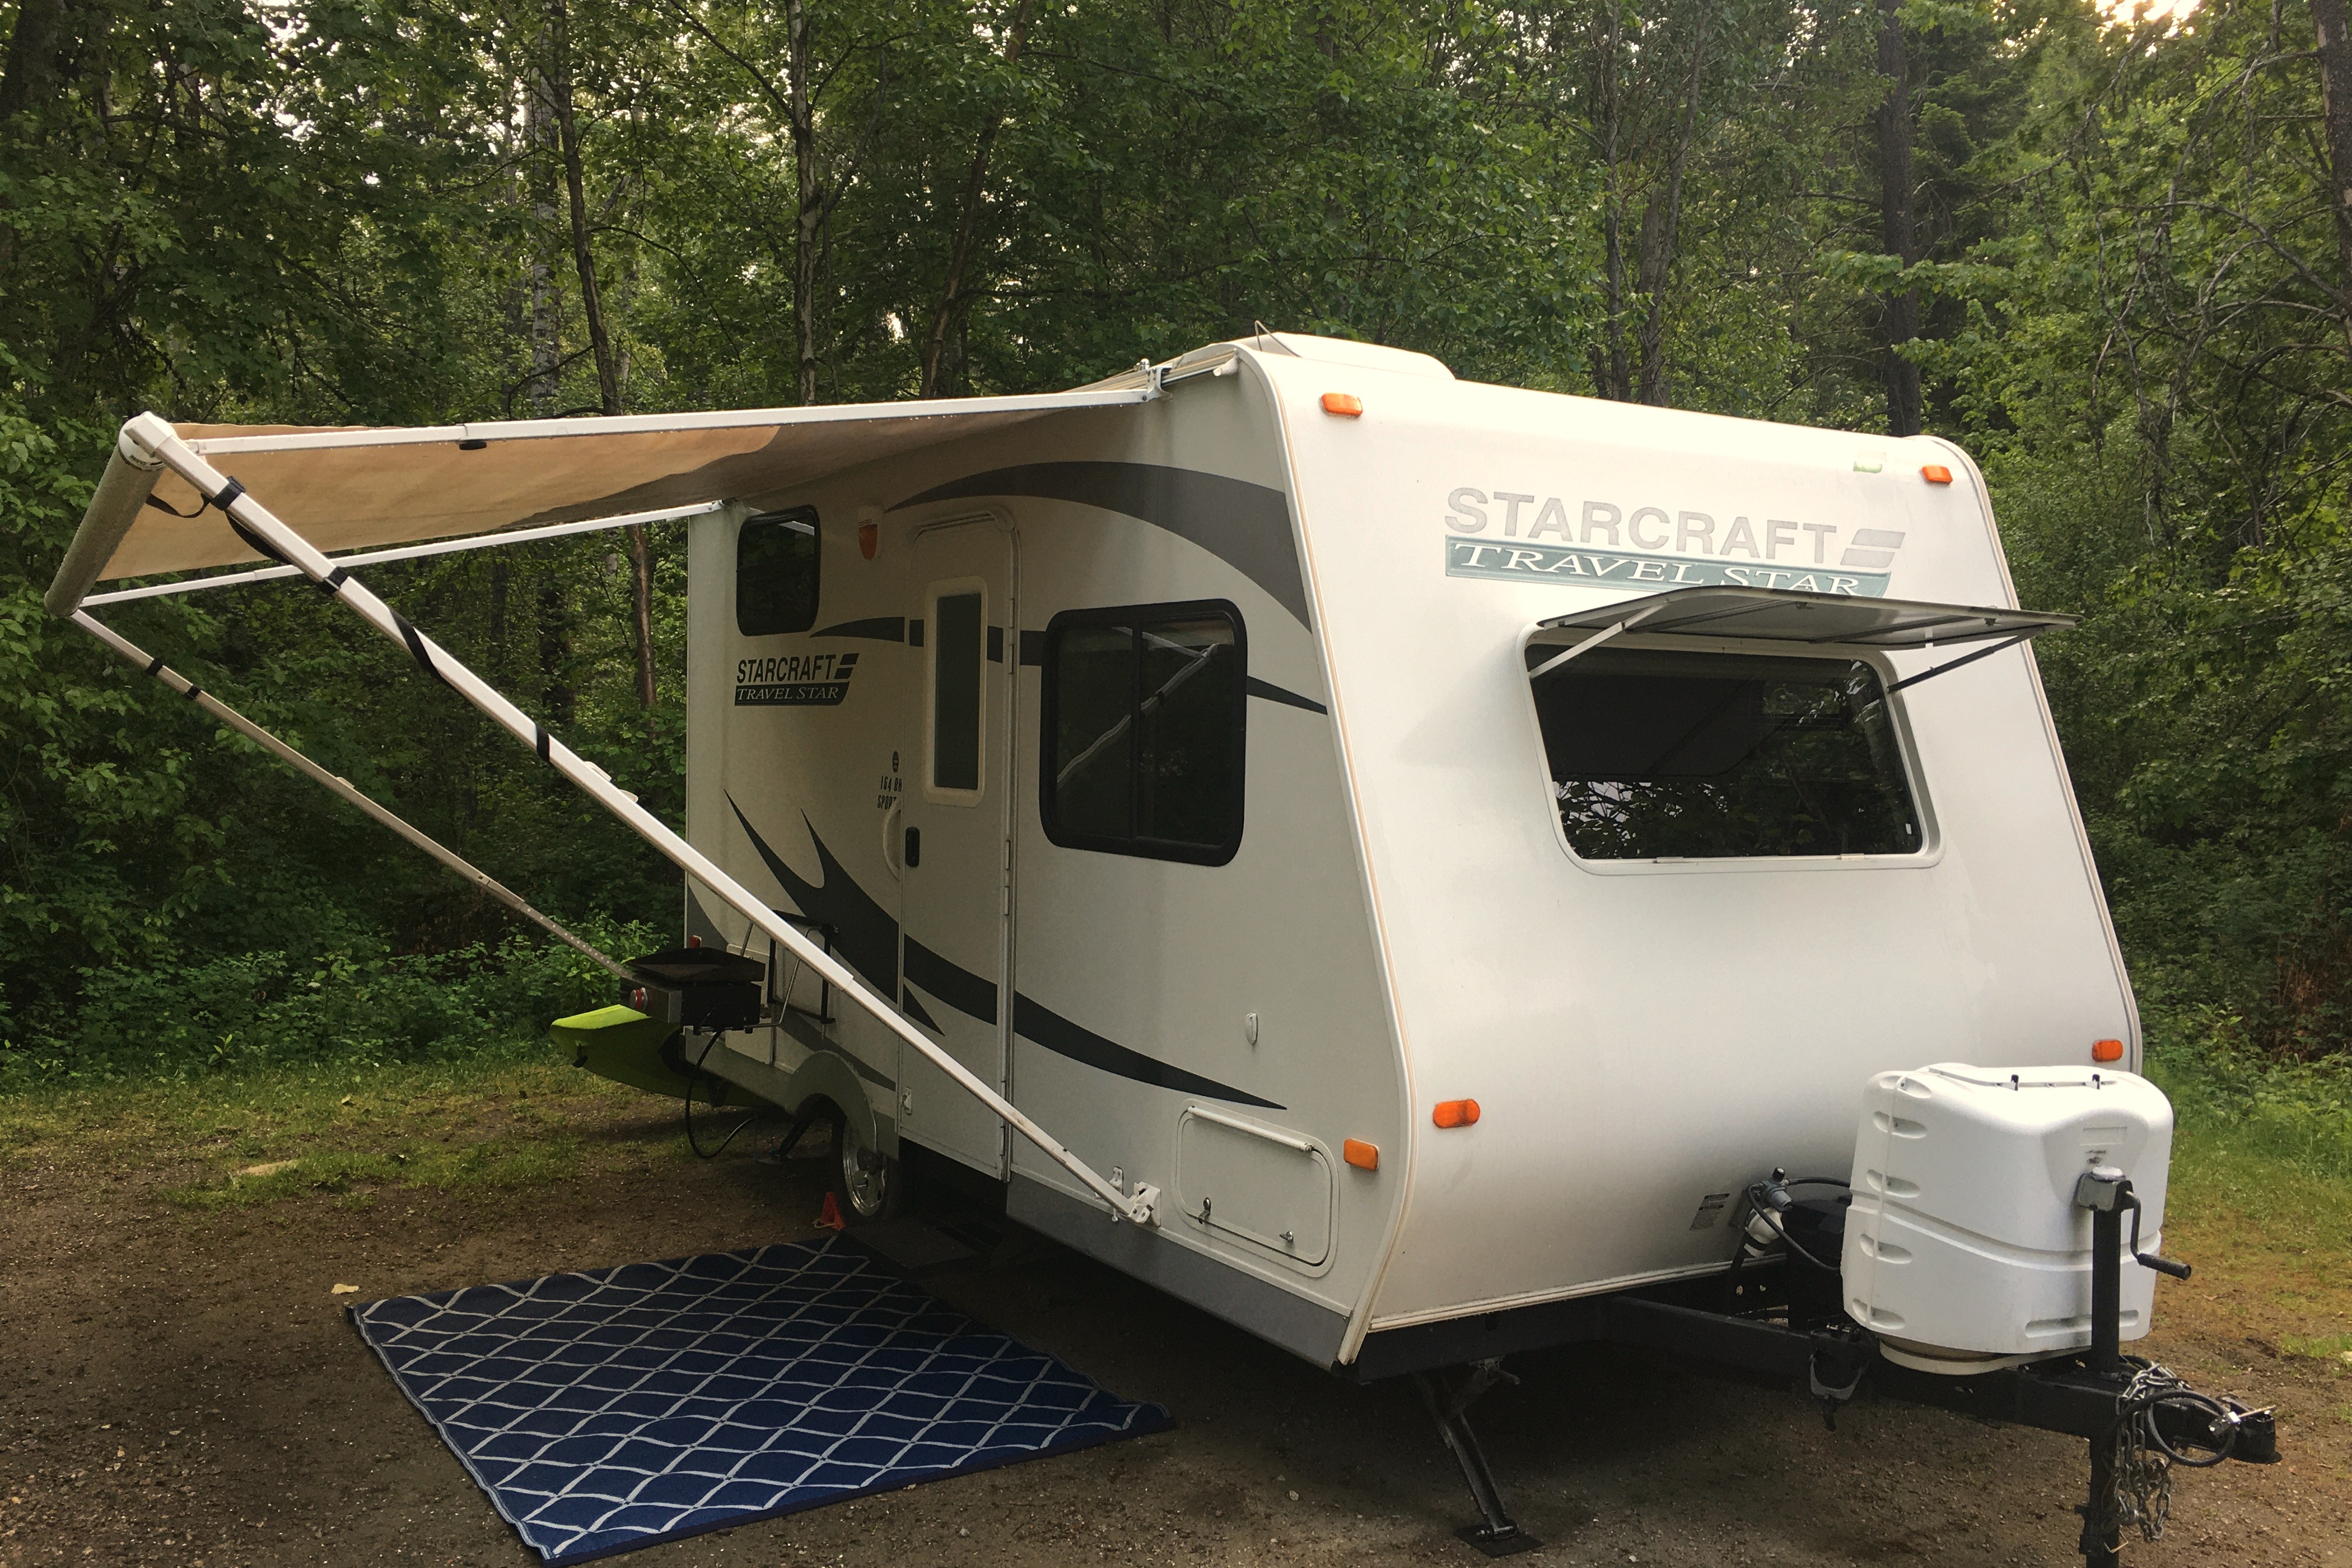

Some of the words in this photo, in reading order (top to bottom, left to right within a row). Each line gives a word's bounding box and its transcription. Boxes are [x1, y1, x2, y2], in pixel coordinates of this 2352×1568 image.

[1445, 487, 1837, 564] STARCRAFT
[1455, 544, 1703, 584] TRAVEL
[1720, 568, 1863, 596] STAR
[737, 654, 836, 683] STARCRAFT
[737, 688, 793, 700] TRAVEL
[797, 687, 838, 699] STAR
[880, 776, 892, 792] 164
